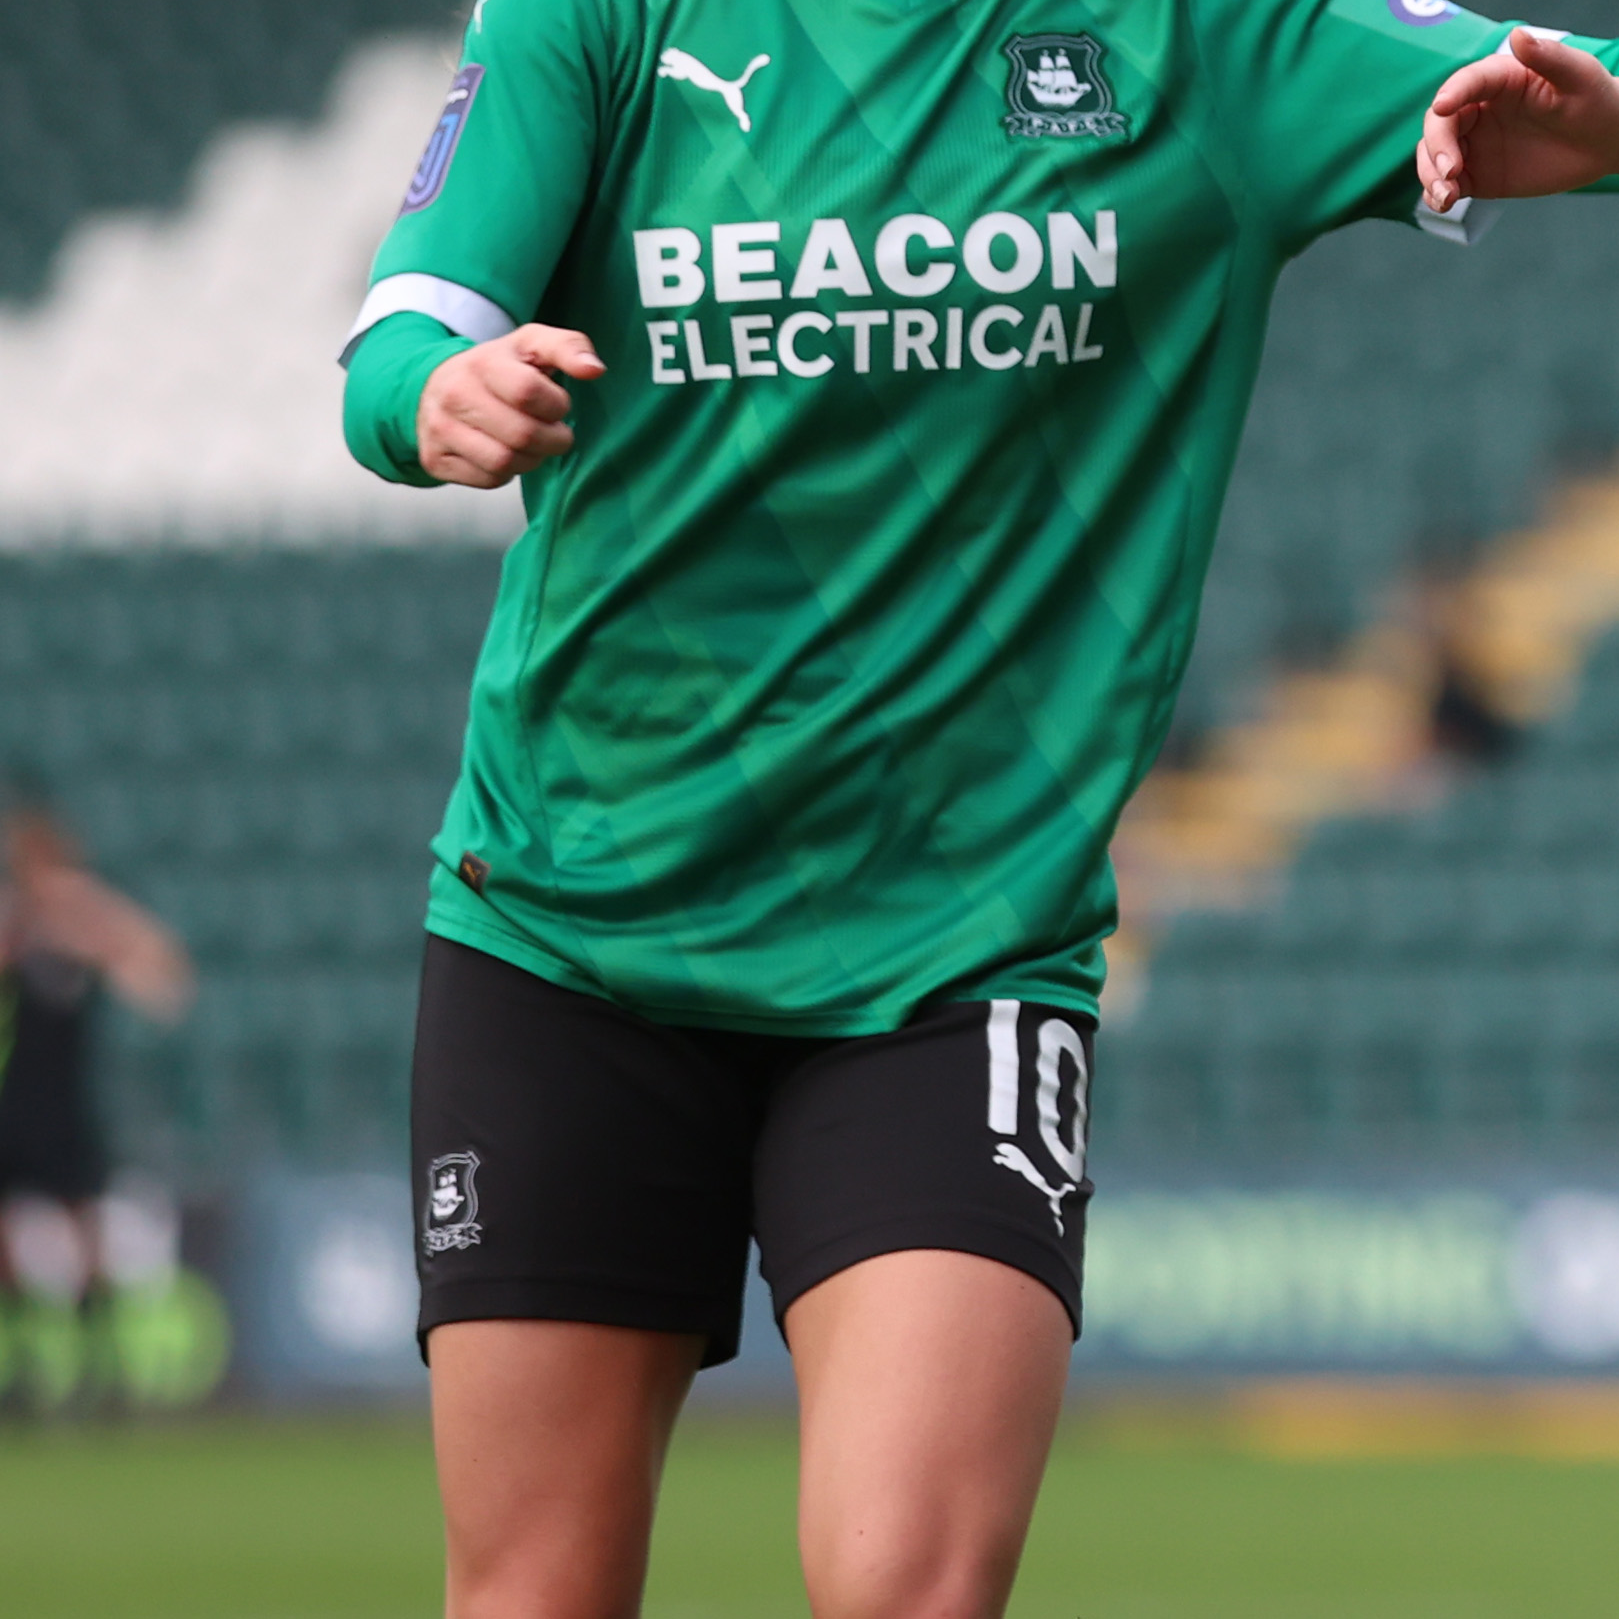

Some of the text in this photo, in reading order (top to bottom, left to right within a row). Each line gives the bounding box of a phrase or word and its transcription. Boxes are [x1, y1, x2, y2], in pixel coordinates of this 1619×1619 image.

[633, 210, 1117, 308] BEACON
[647, 303, 1104, 384] ELECTRICAL
[987, 999, 1088, 1181] 10
